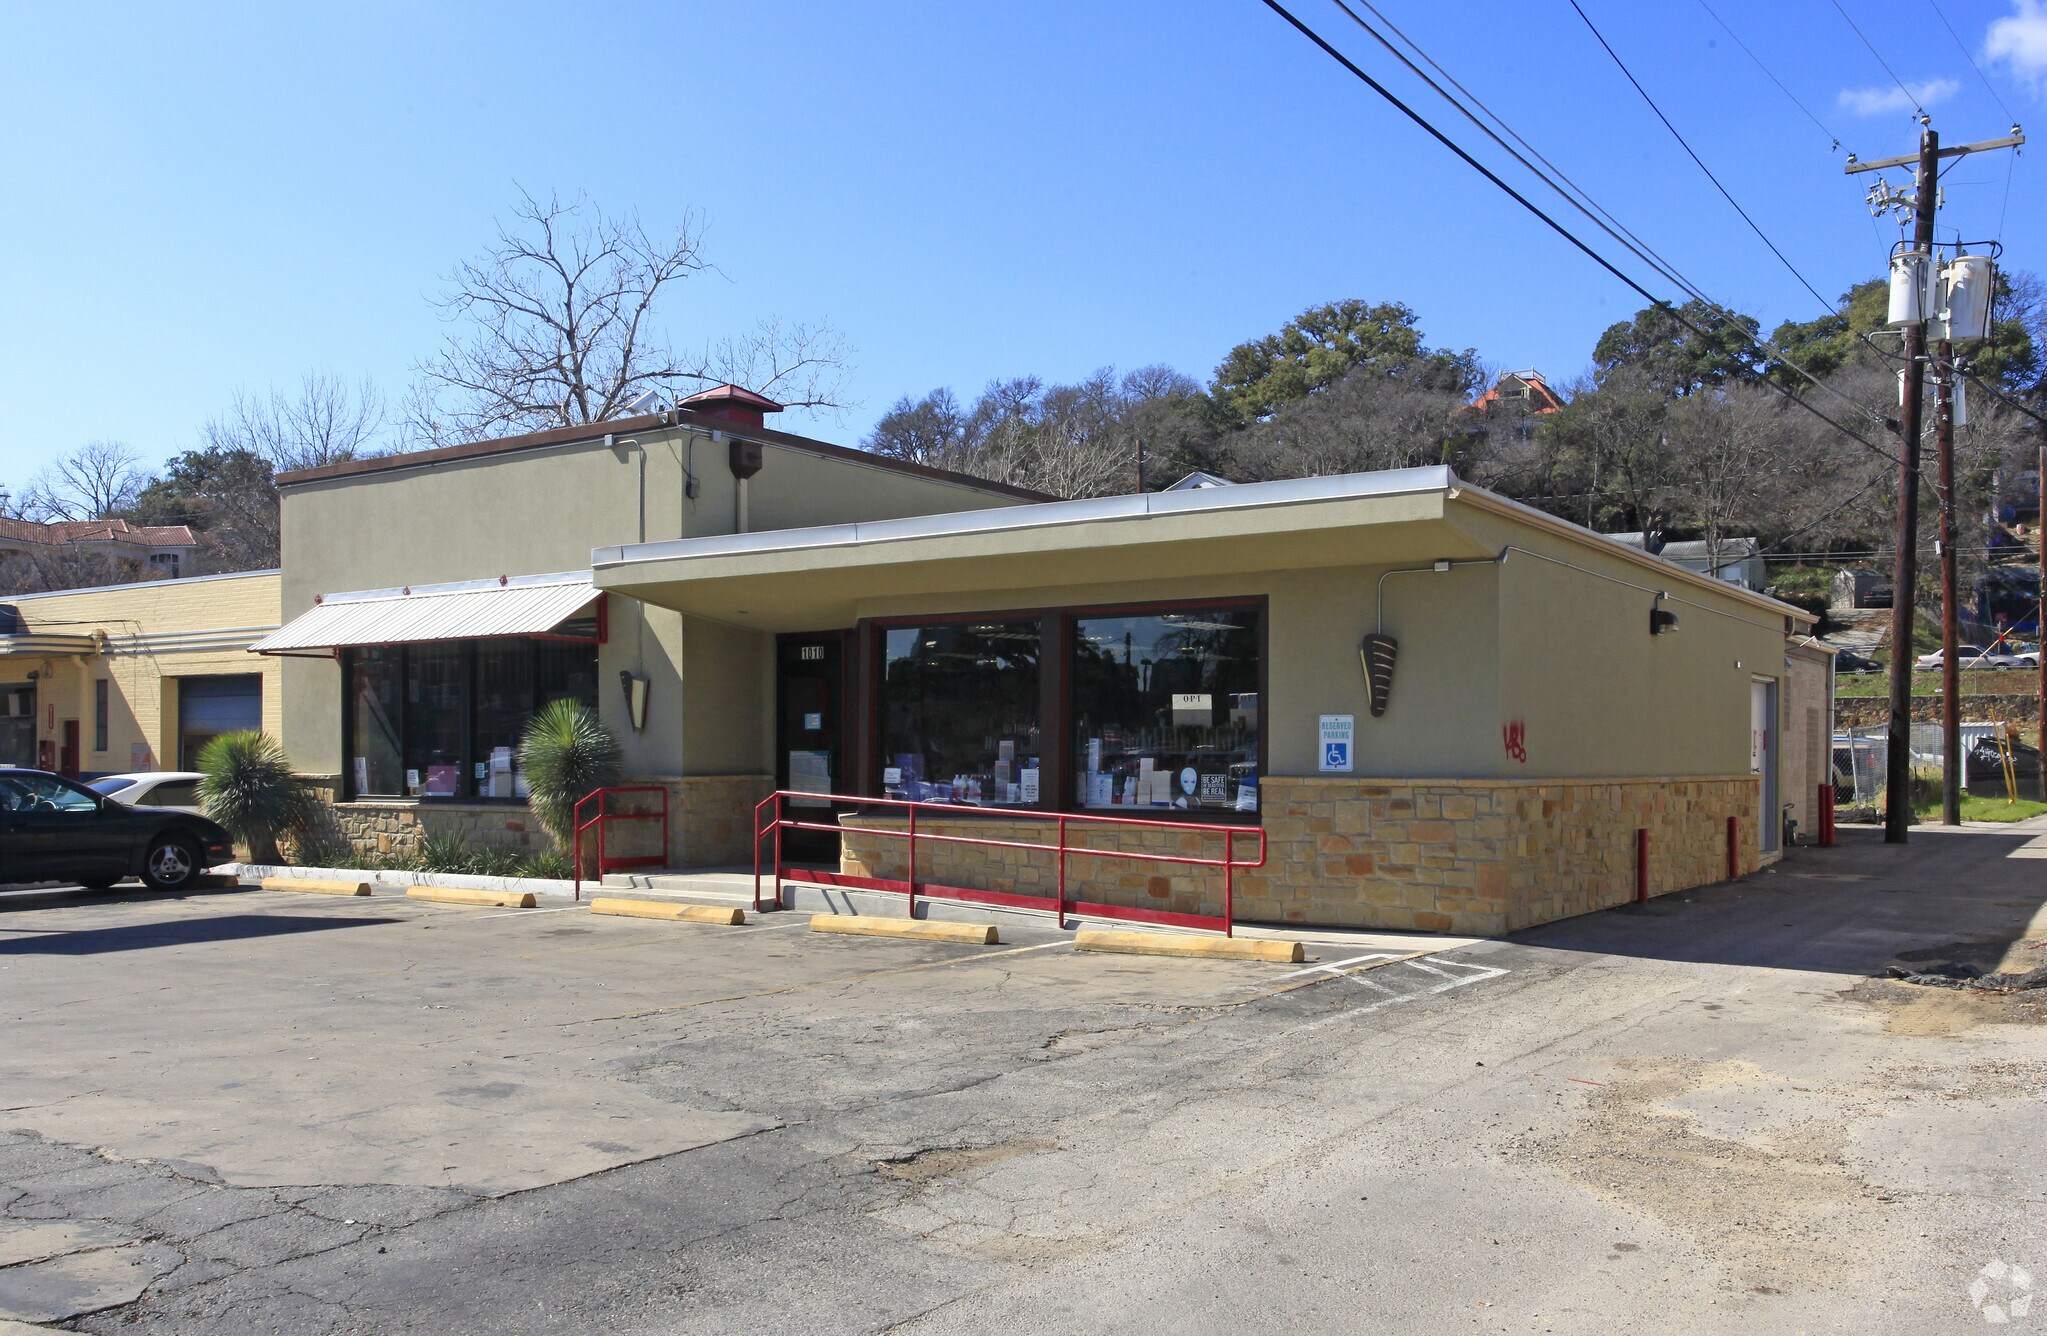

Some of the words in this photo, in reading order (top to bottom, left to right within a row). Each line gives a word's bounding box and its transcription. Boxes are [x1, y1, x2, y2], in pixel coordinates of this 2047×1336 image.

[803, 646, 823, 659] 1010
[1321, 721, 1352, 730] RESERVED
[1323, 731, 1350, 739] PARKING
[1203, 776, 1210, 784] BE
[1211, 776, 1225, 784] SAFE
